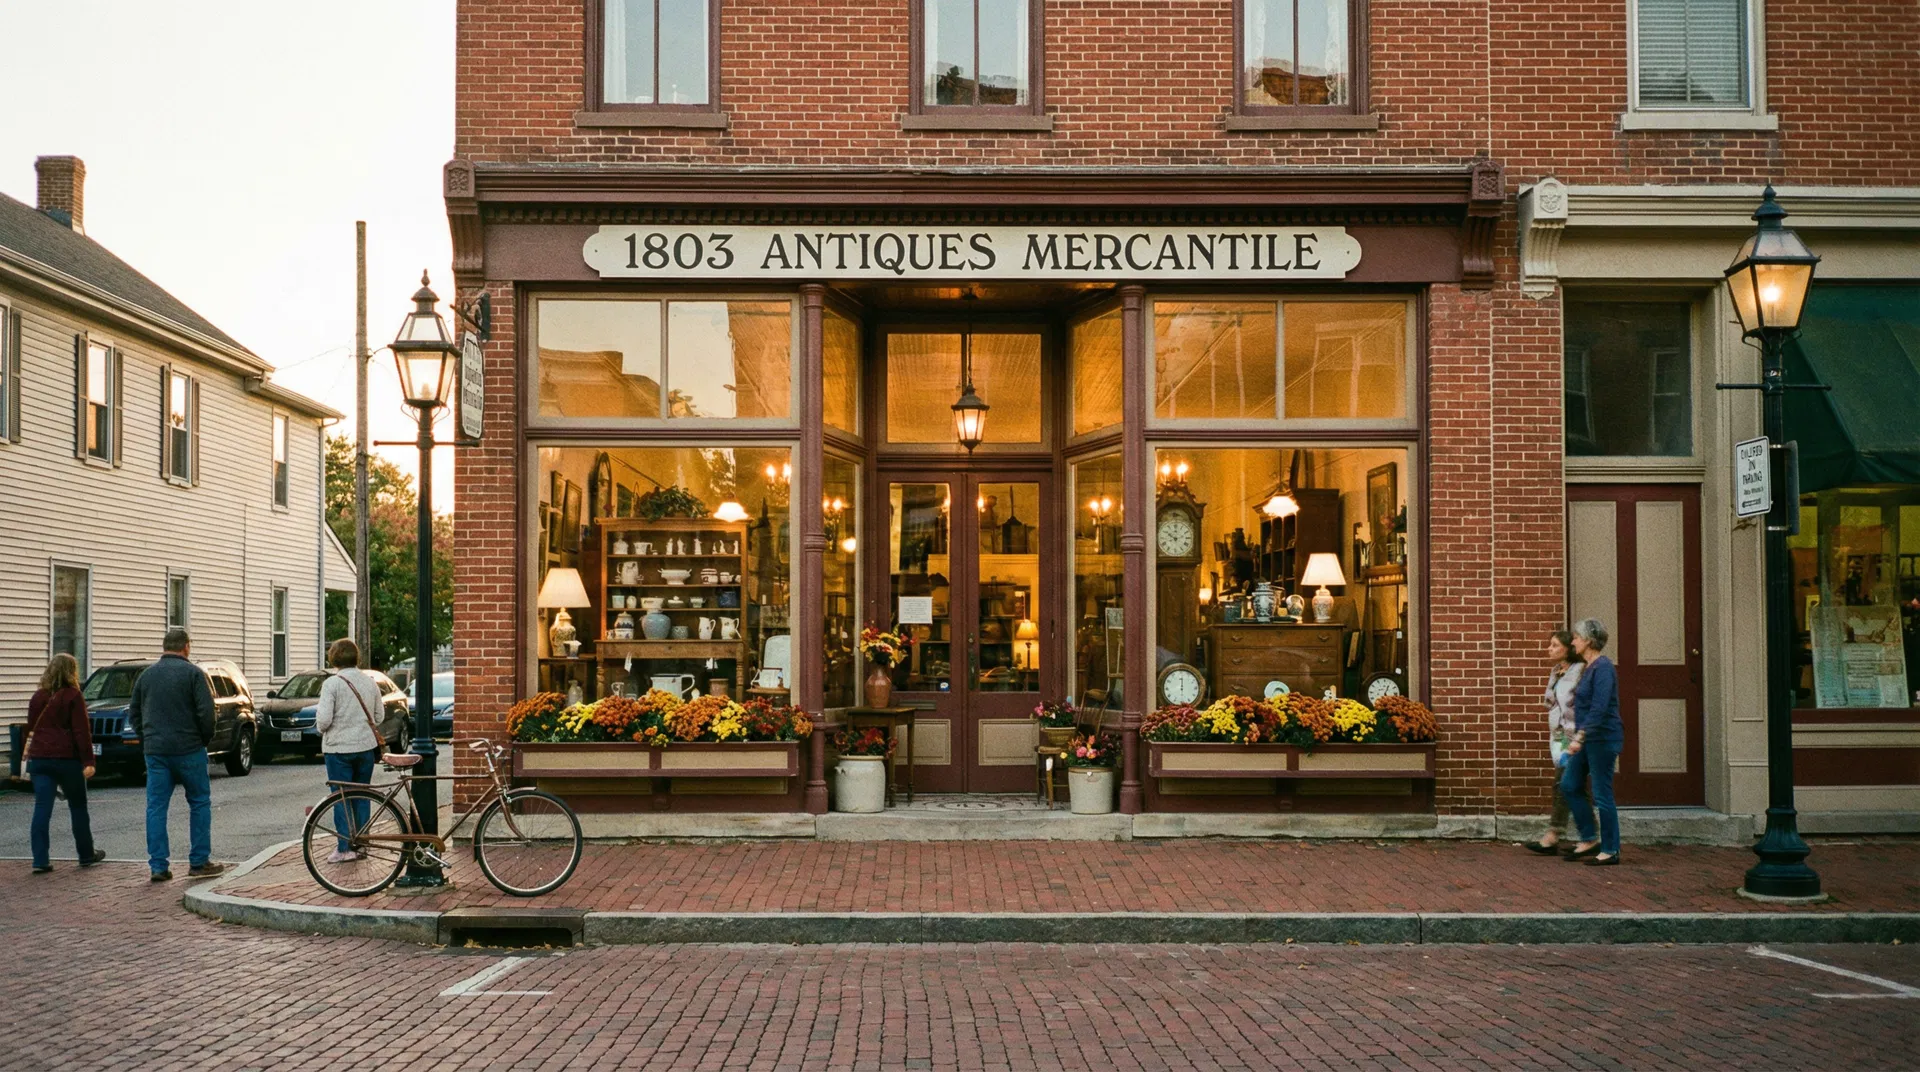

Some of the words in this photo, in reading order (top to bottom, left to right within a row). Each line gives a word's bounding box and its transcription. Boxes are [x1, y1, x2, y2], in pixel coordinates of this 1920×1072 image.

[624, 232, 734, 271] 1803
[760, 232, 997, 277] ANTIQUES
[1021, 232, 1321, 271] MERCANTILE
